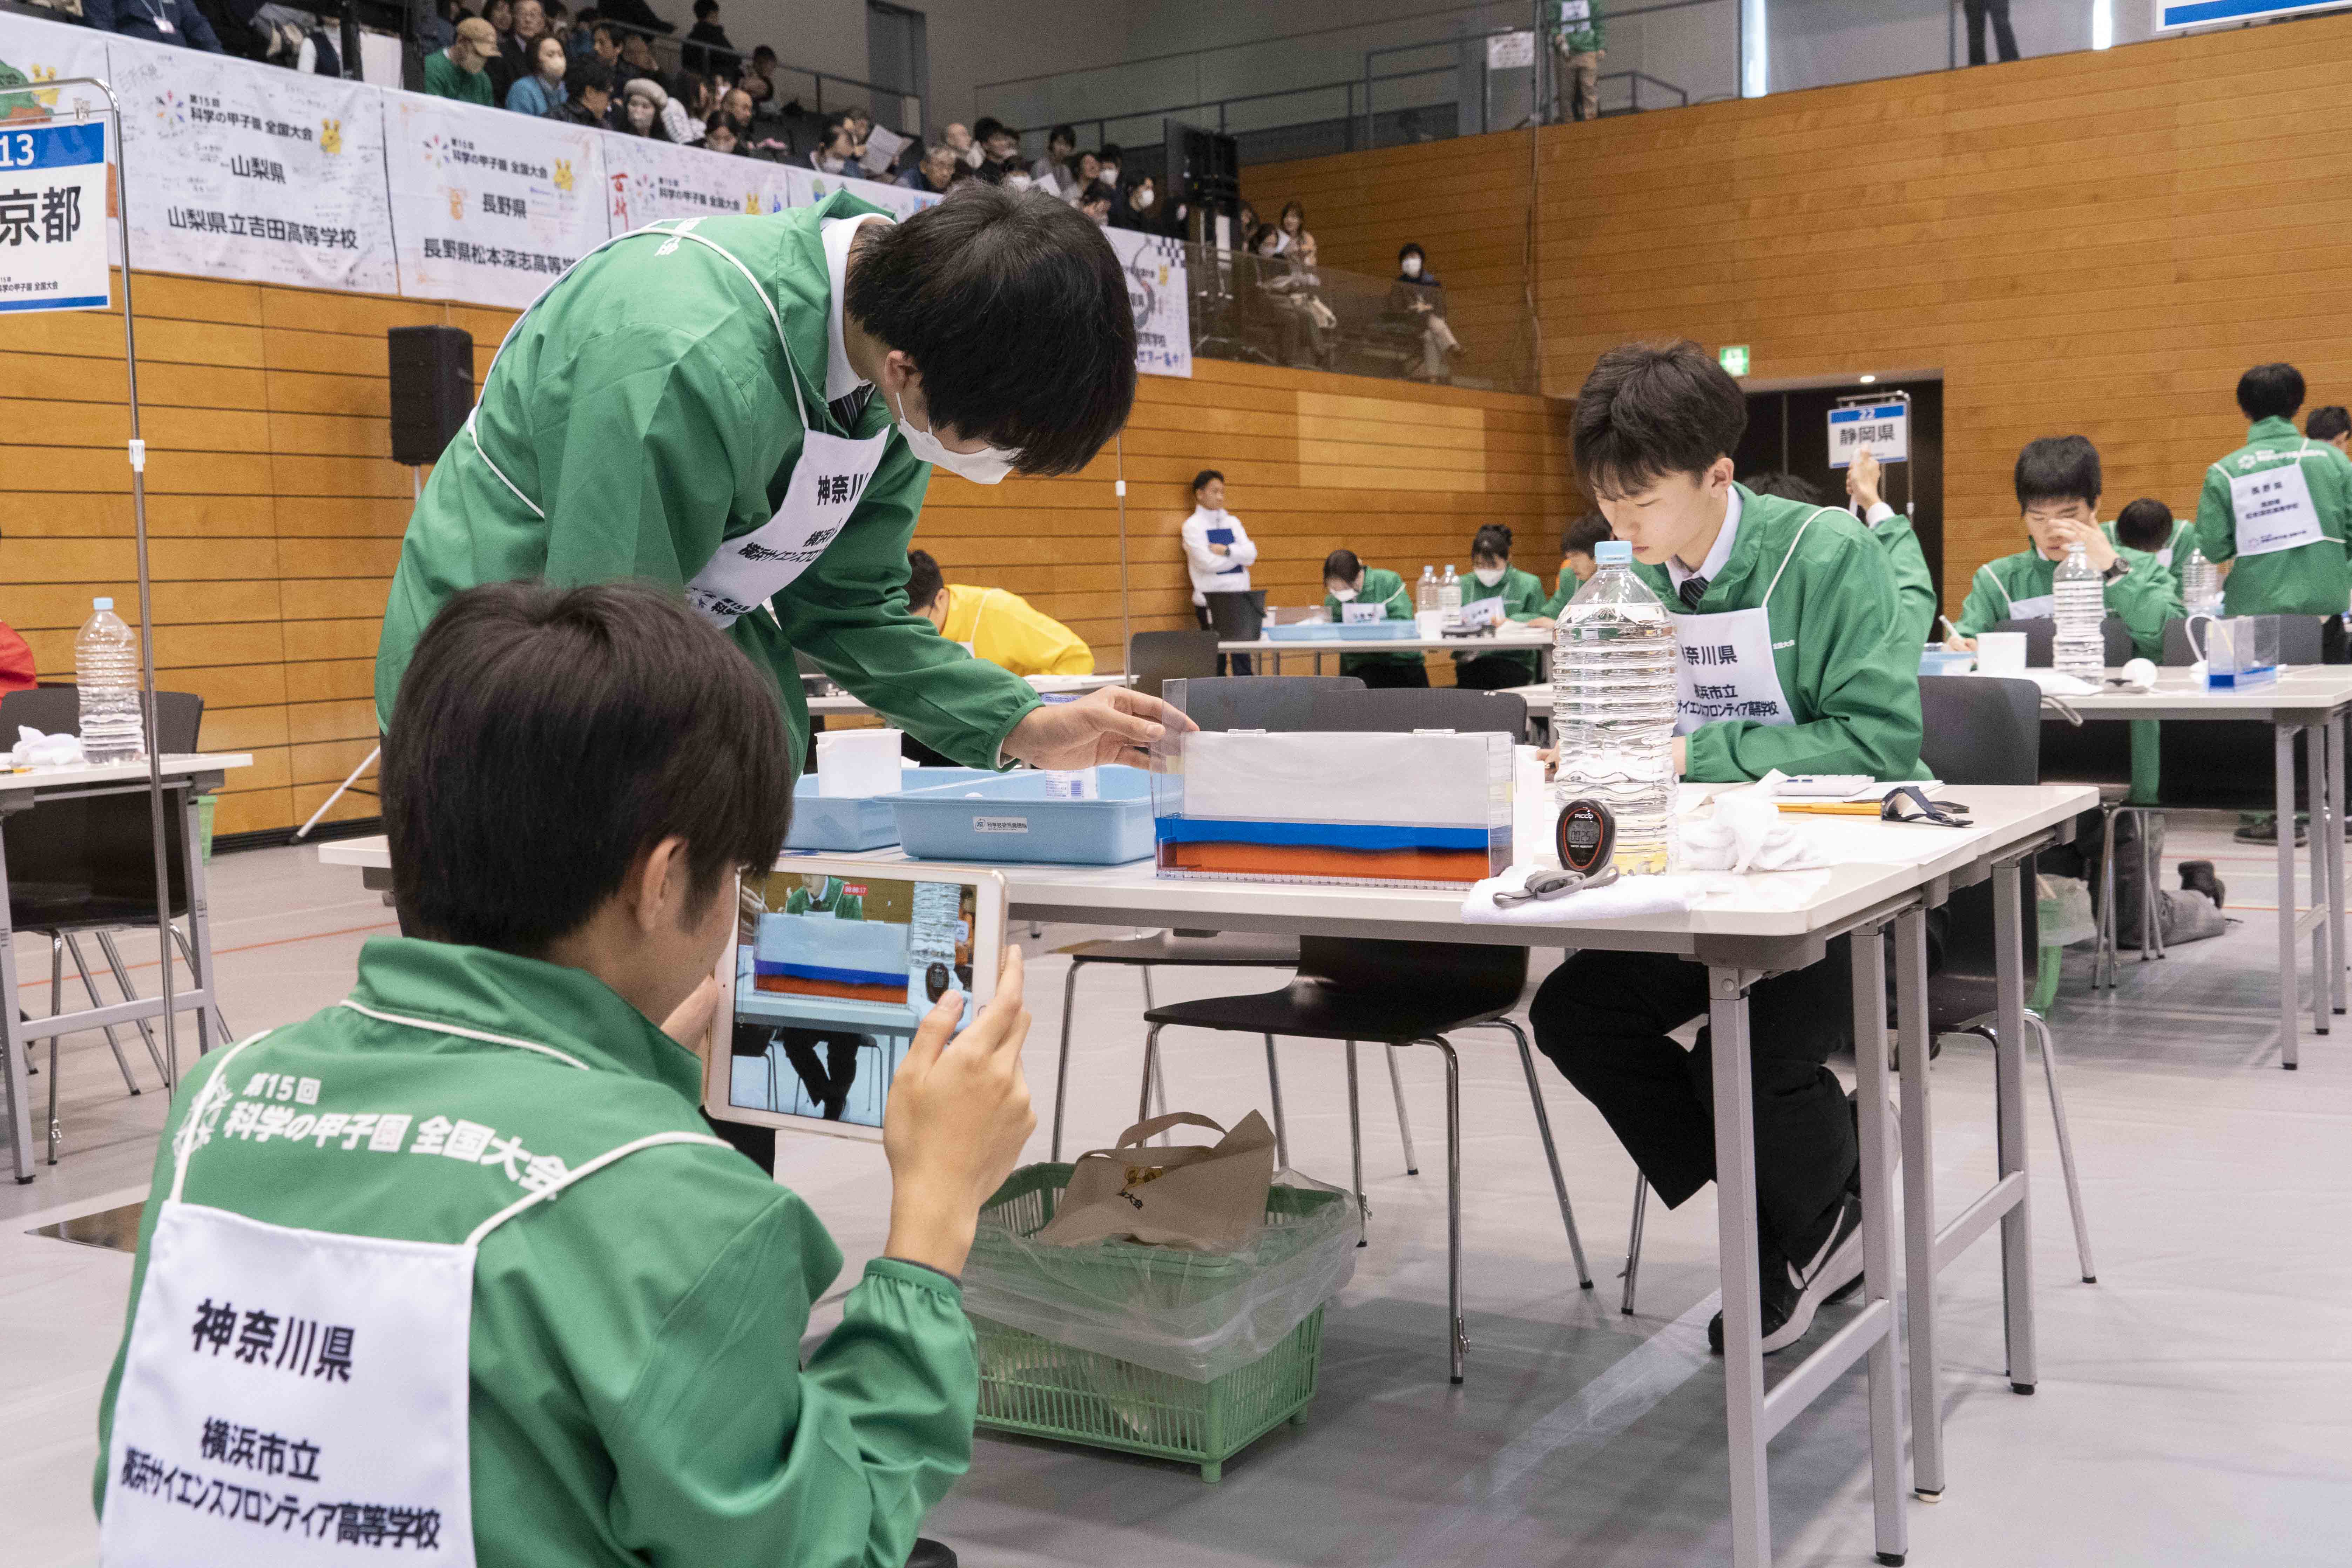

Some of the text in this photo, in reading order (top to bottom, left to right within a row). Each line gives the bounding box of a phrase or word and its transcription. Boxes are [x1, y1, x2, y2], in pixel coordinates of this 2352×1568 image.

[190, 94, 220, 108] 第15回
[190, 106, 312, 141] 科学の甲子園 全国大会
[0, 134, 34, 167] 13
[452, 149, 548, 179] 科学の甲子園 全国大会
[231, 155, 286, 184] 山梨県
[483, 192, 526, 219] 長野県
[168, 205, 359, 250] 山梨県立吉田高等学校
[1840, 424, 1895, 446] 静岡県
[242, 1072, 321, 1105] 第15回
[223, 1101, 570, 1201] 科学の甲子園 全国大会
[192, 1298, 355, 1383] 神奈川県
[201, 1416, 320, 1483] 横浜市立
[121, 1447, 441, 1550] 横浜サイエンスフロンティア高等学校
